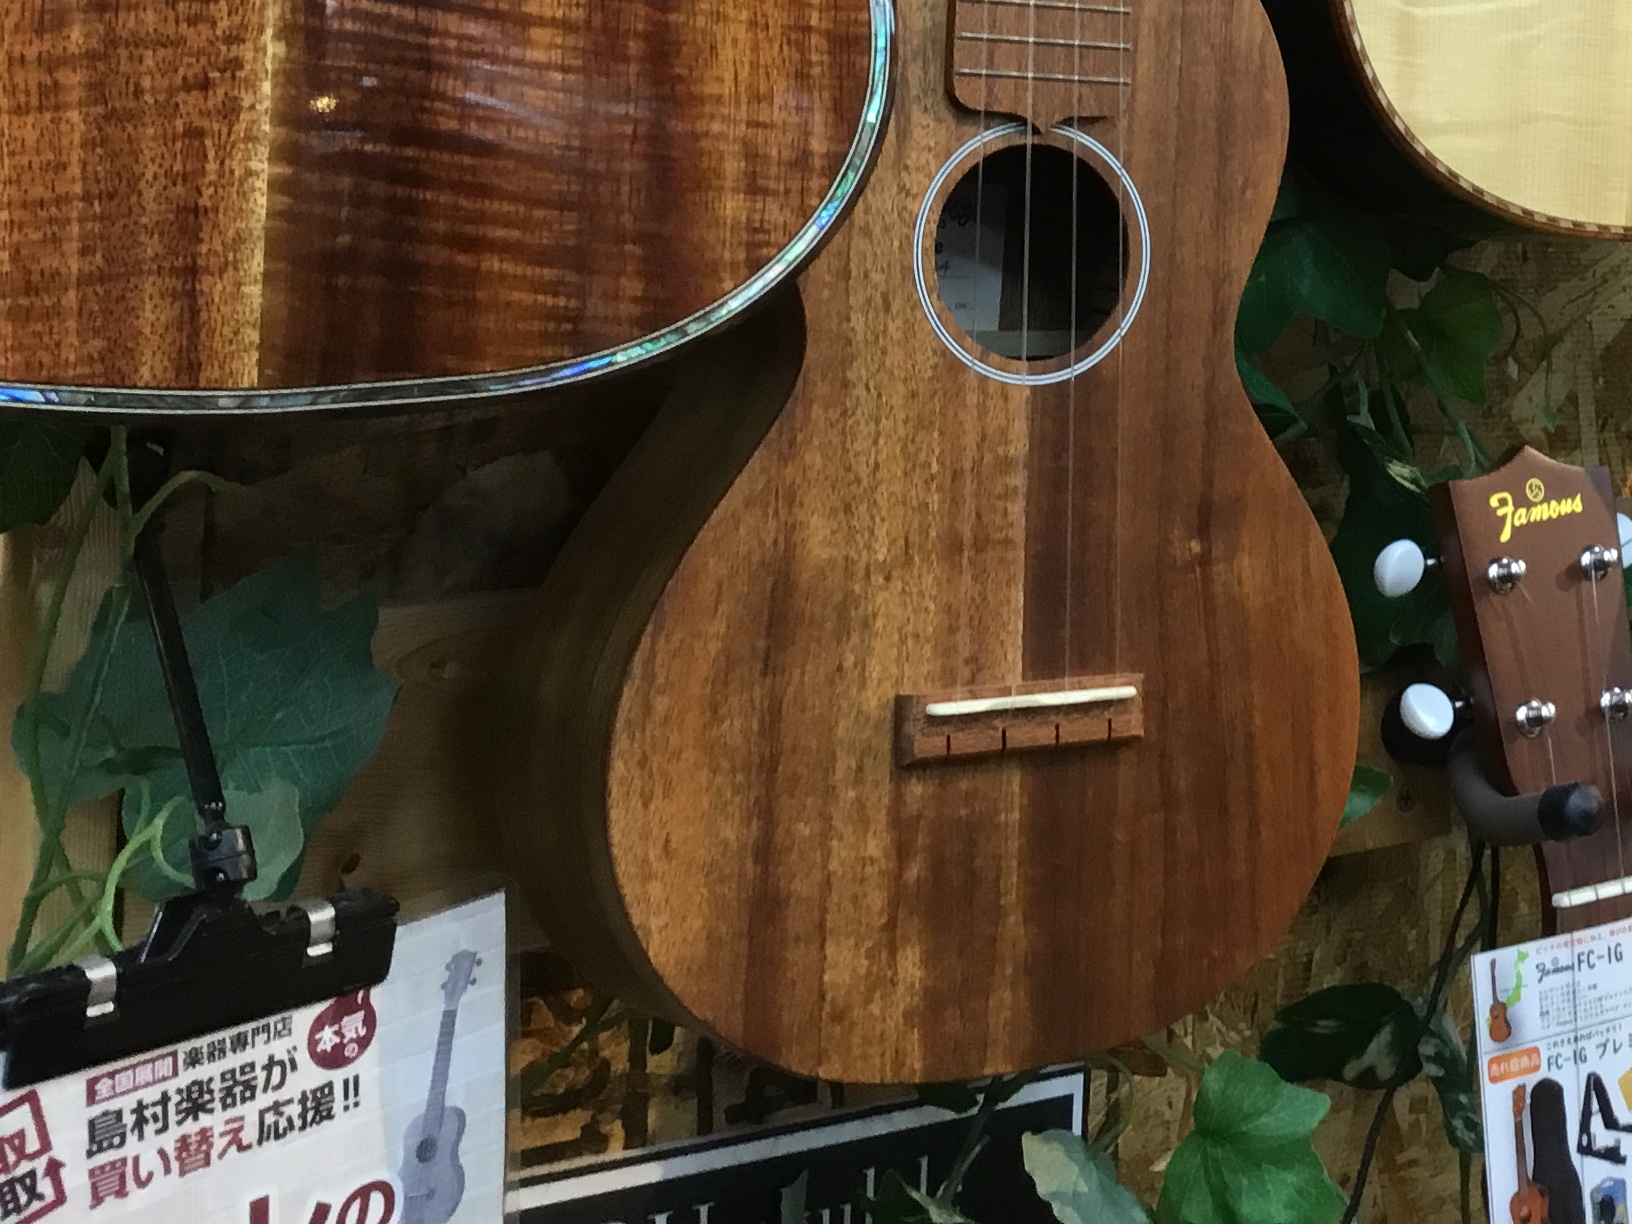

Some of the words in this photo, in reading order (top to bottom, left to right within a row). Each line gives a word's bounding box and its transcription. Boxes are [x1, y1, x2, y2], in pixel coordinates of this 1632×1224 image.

[1489, 491, 1583, 543] Famous
[182, 1014, 294, 1072] 楽器専門店
[86, 1045, 298, 1160] 島村楽器が
